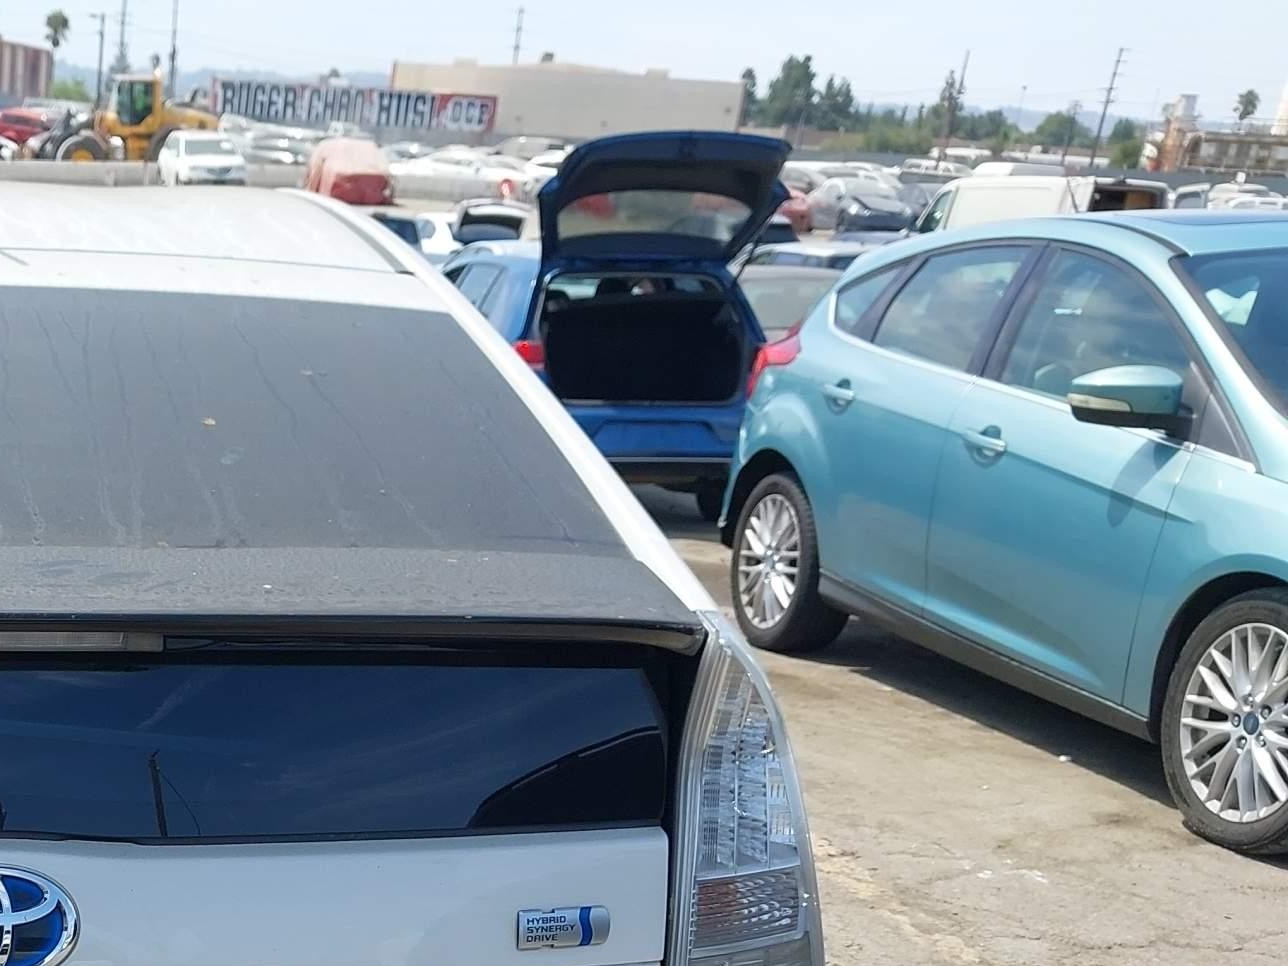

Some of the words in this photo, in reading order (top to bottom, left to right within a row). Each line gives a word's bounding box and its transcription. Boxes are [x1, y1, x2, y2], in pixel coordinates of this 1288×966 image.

[526, 916, 567, 926] HYBRID
[526, 924, 576, 934] SYNERGY
[526, 933, 559, 943] DRIVE
